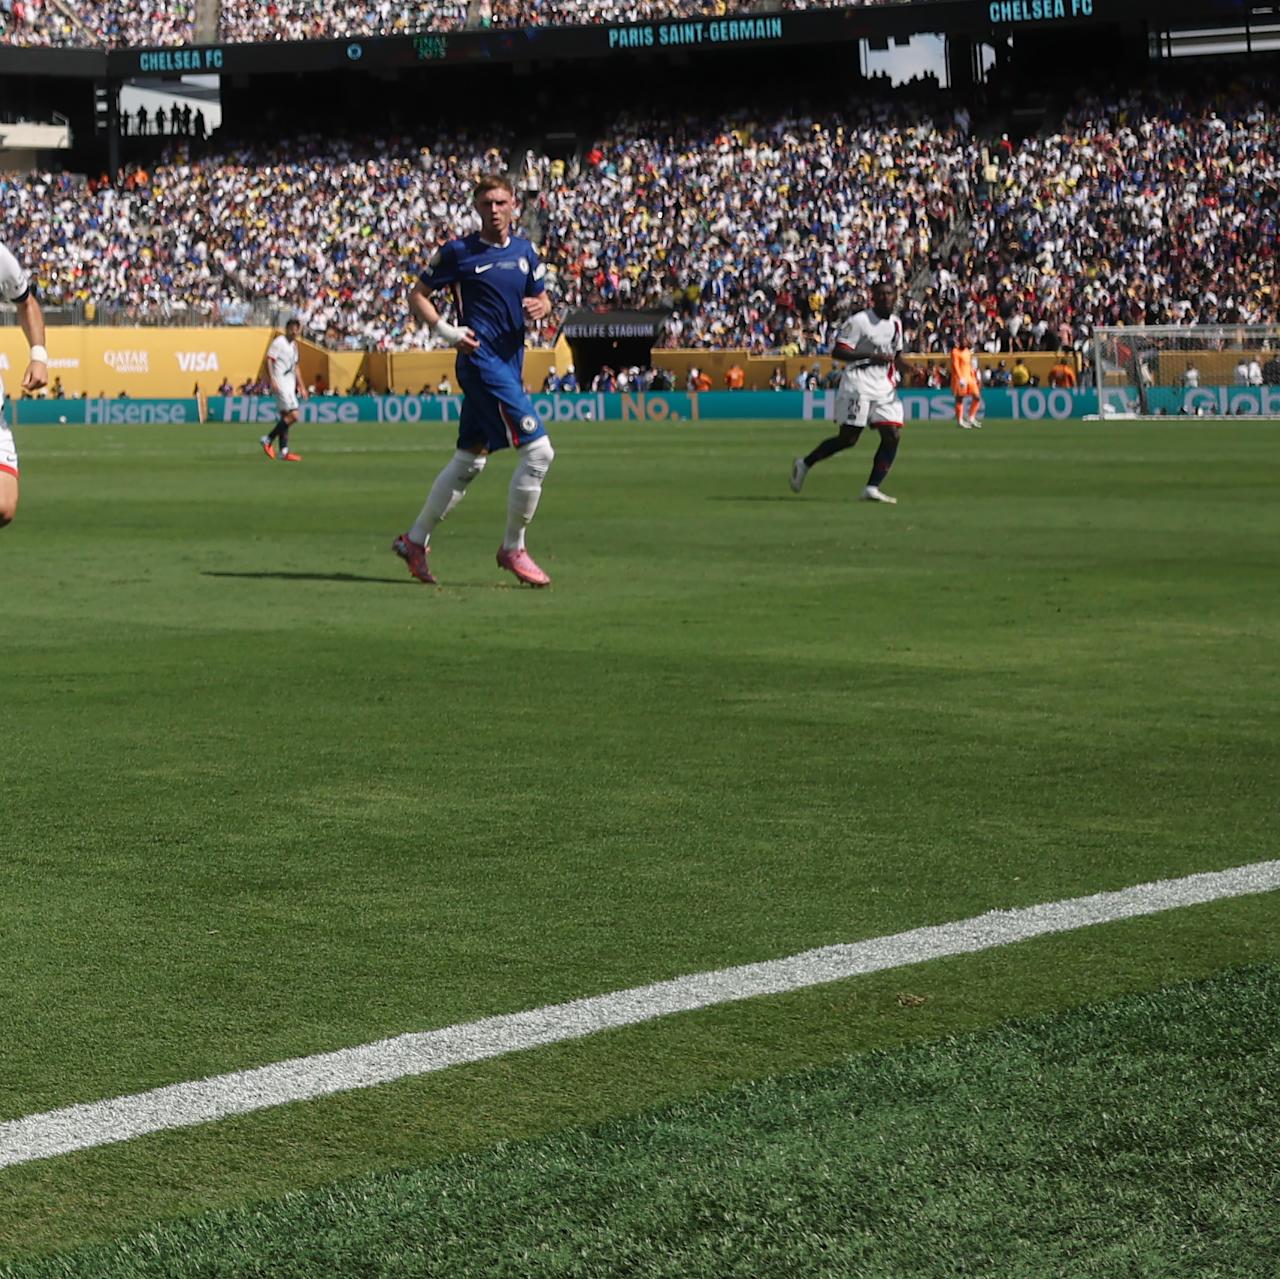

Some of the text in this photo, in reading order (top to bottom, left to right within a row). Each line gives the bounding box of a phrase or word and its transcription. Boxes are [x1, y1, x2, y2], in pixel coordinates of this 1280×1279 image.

[609, 18, 782, 47] PARIS SAINT-GERMAIN
[140, 50, 223, 71] CHELSEA FC
[563, 324, 654, 338] METLIFE STADIUM
[47, 358, 79, 369] sense
[104, 350, 149, 367] QATAR
[177, 352, 219, 371] VISA
[84, 399, 186, 424] Hisense
[223, 396, 360, 422] Hisnse
[535, 393, 605, 421] obal
[621, 393, 679, 421] No.
